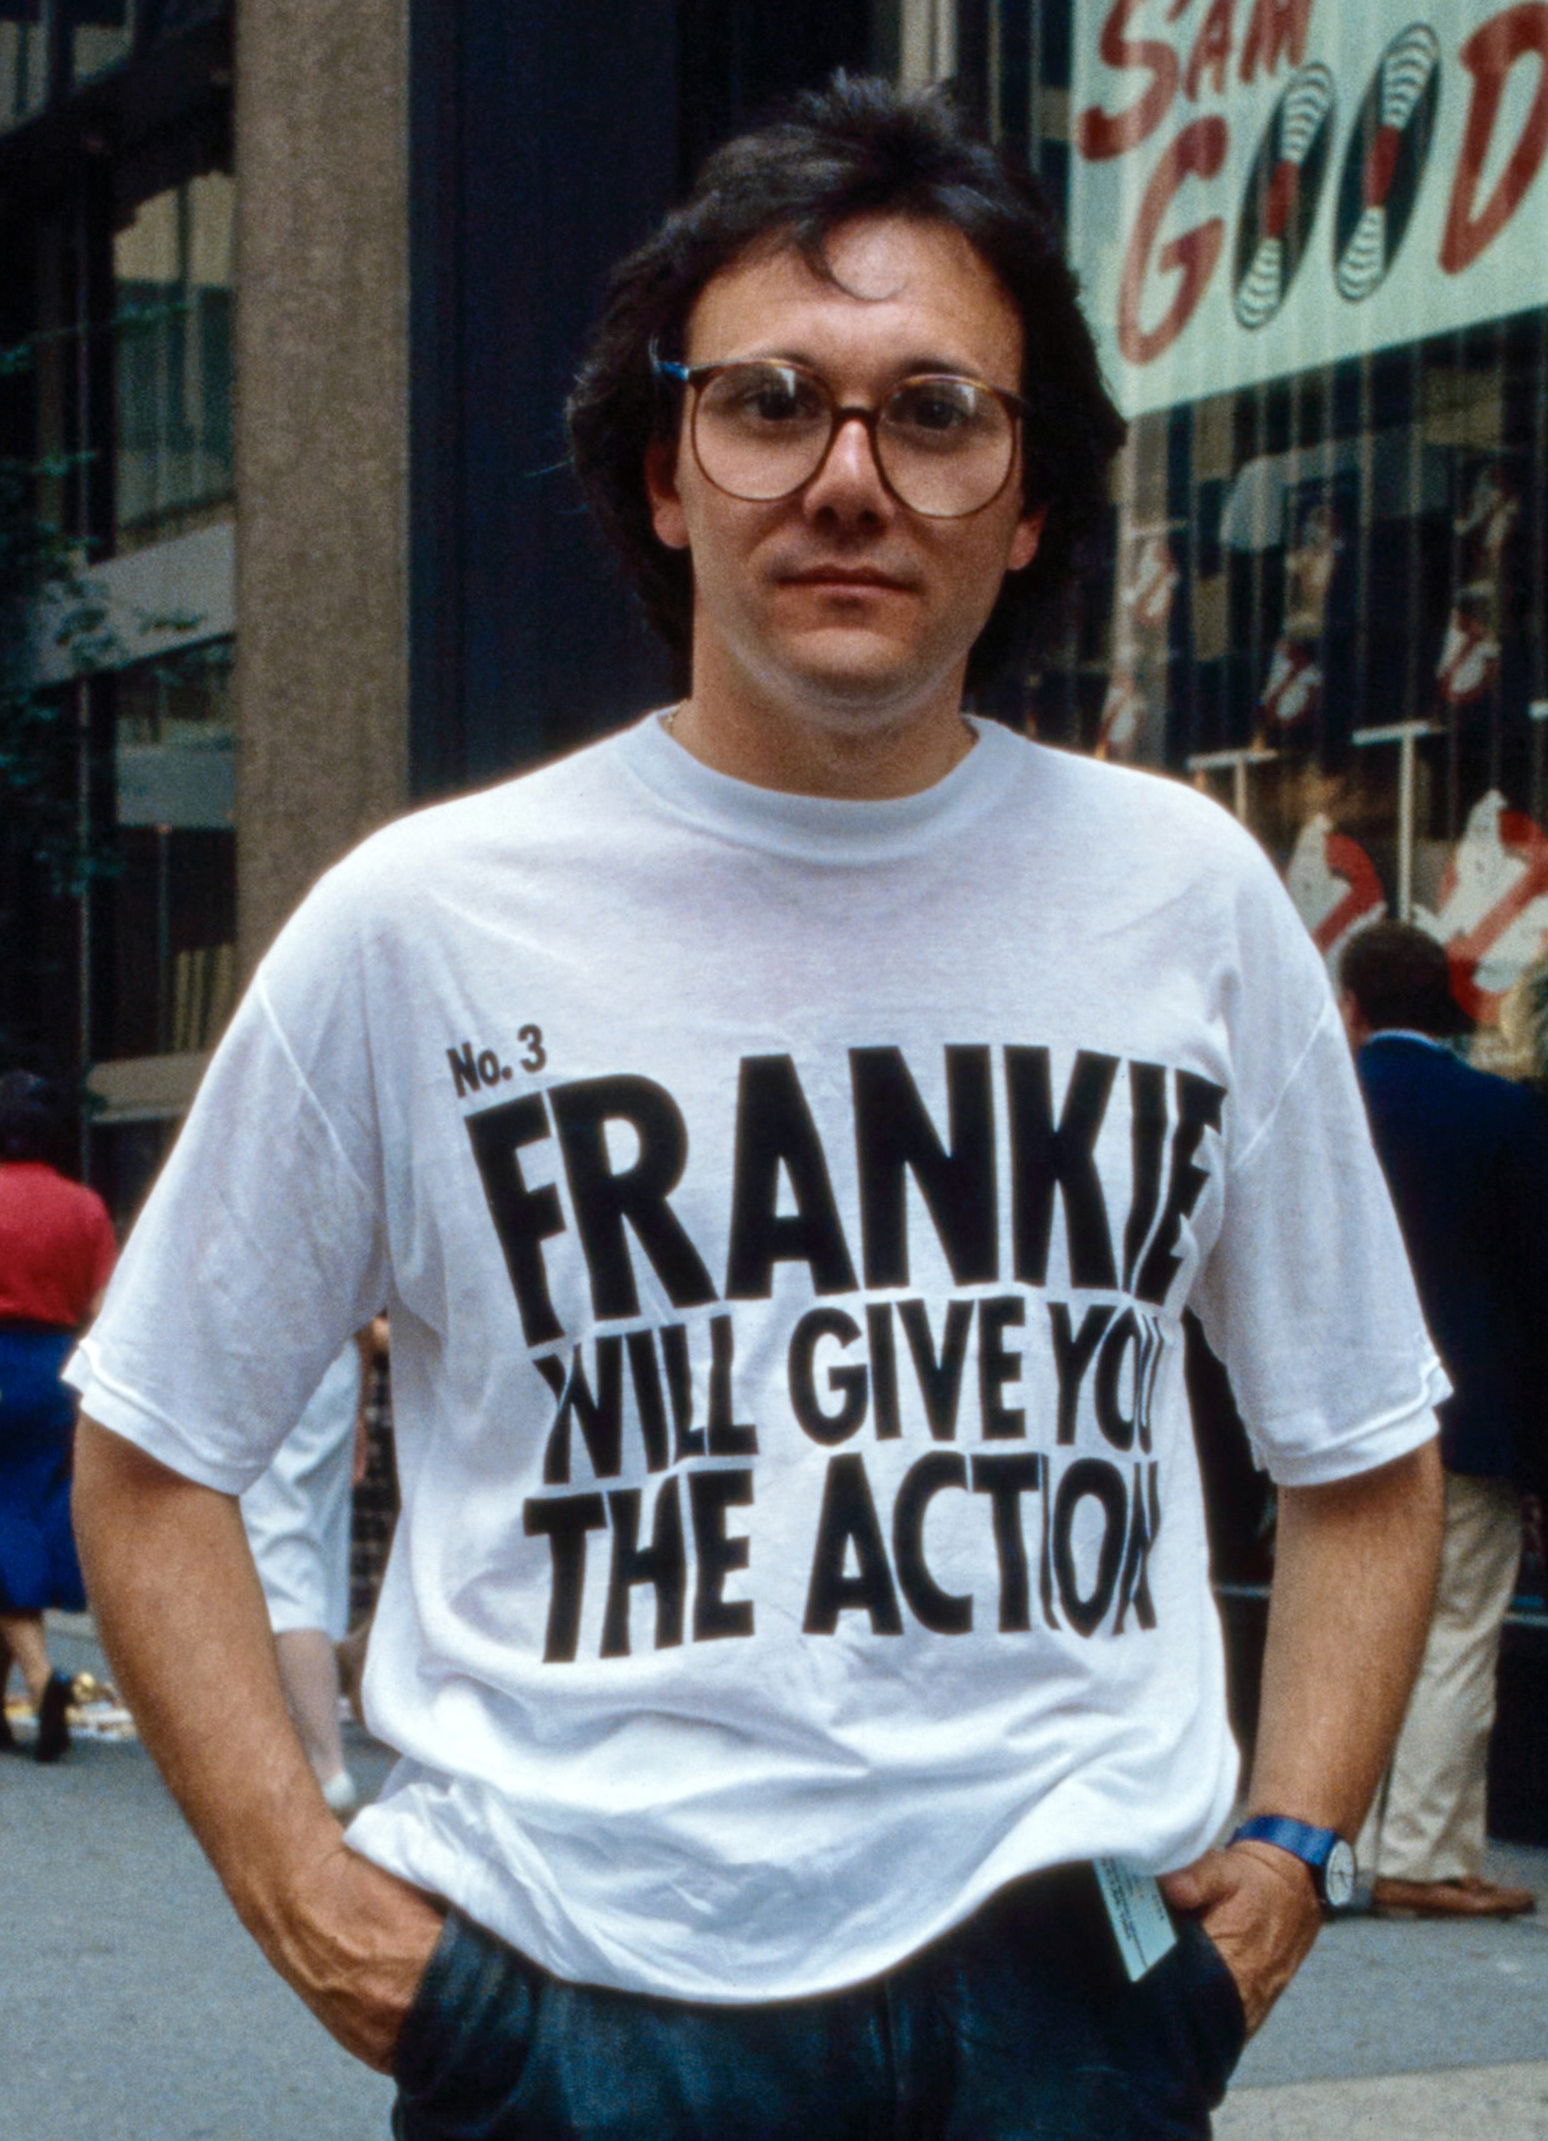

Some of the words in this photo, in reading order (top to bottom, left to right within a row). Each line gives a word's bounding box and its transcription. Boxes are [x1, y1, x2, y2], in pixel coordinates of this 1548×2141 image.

[1078, 0, 1311, 163] SAM
[447, 1041, 512, 1098] No.
[518, 1024, 546, 1072] 3
[464, 1044, 1228, 1347] FRANKIE
[533, 1314, 759, 1485] WILL
[787, 1294, 1026, 1446] GIVE
[523, 1469, 755, 1663] THE
[802, 1450, 1161, 1638] ACTION
